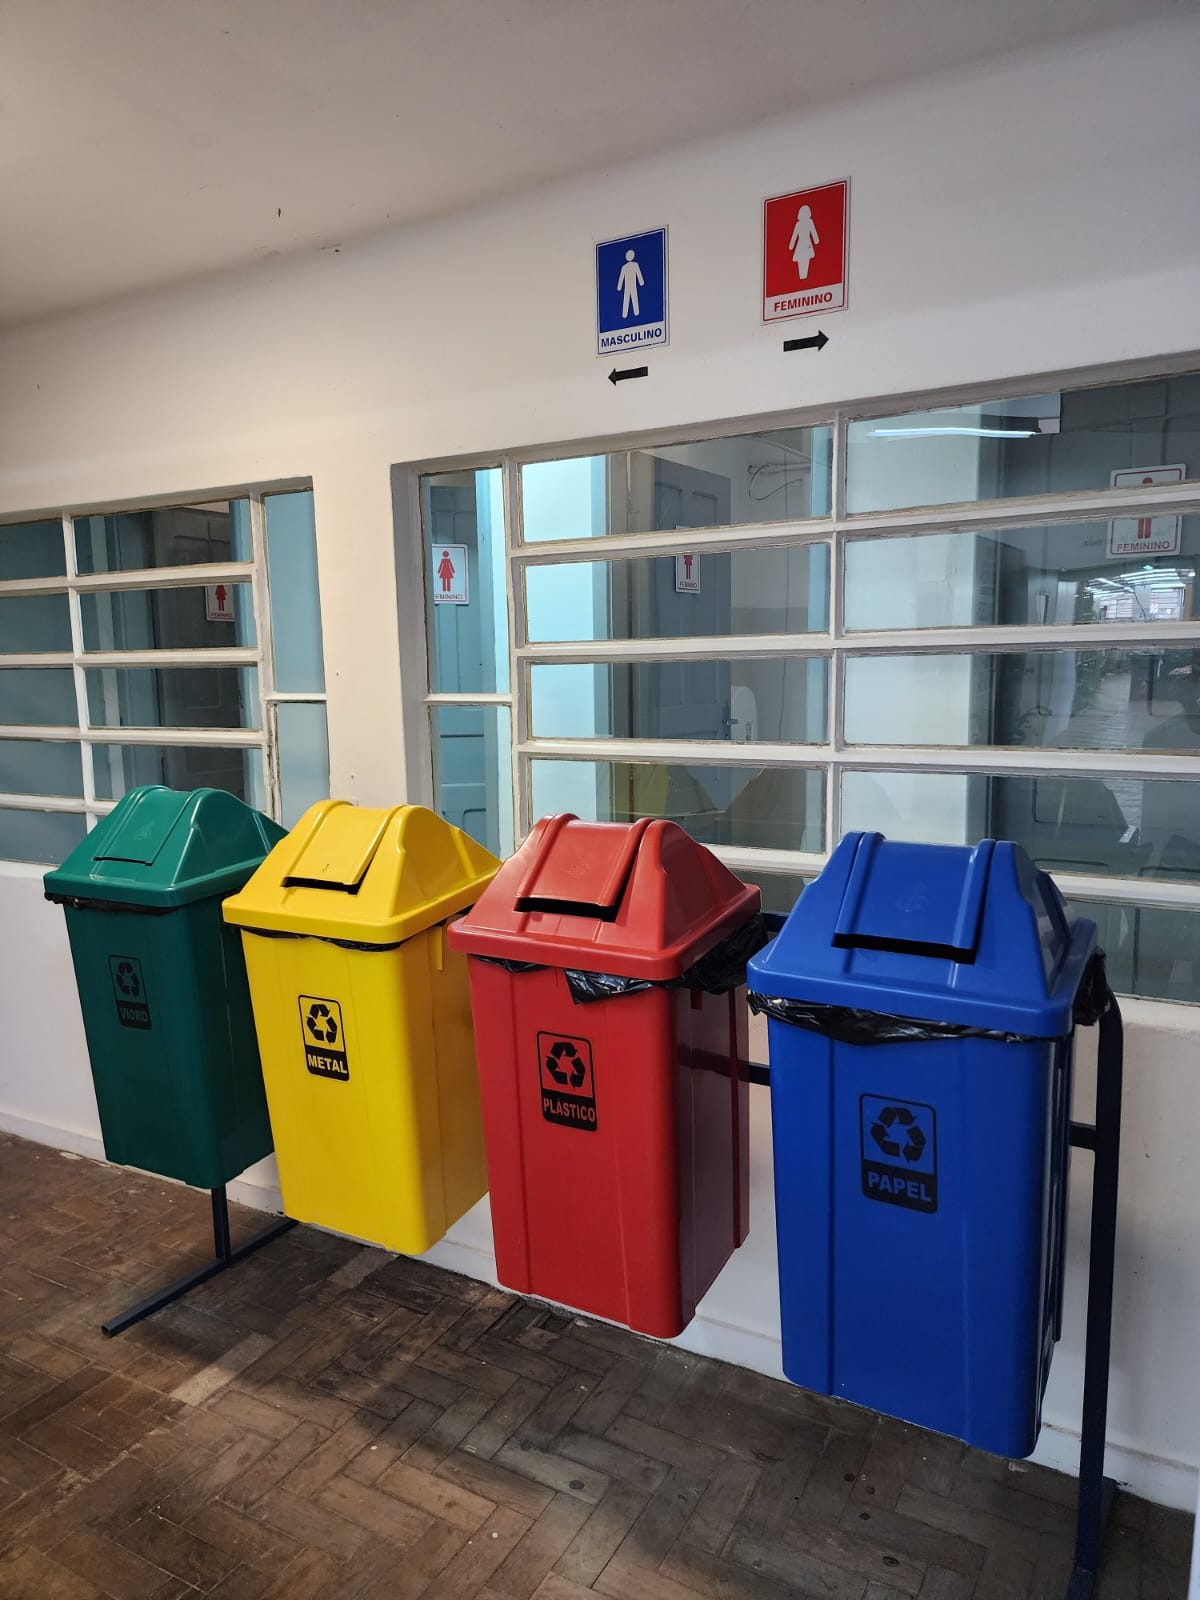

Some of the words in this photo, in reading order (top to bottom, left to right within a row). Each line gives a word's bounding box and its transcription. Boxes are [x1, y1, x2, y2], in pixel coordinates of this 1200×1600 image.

[774, 292, 833, 313] FEMININO
[601, 327, 662, 348] MASCULINO
[1116, 540, 1170, 552] FEMININO
[120, 1007, 149, 1022] VIDRO
[307, 1053, 347, 1074] METAL
[543, 1097, 596, 1122] PLÁSTICO
[867, 1171, 932, 1202] PAPEL
